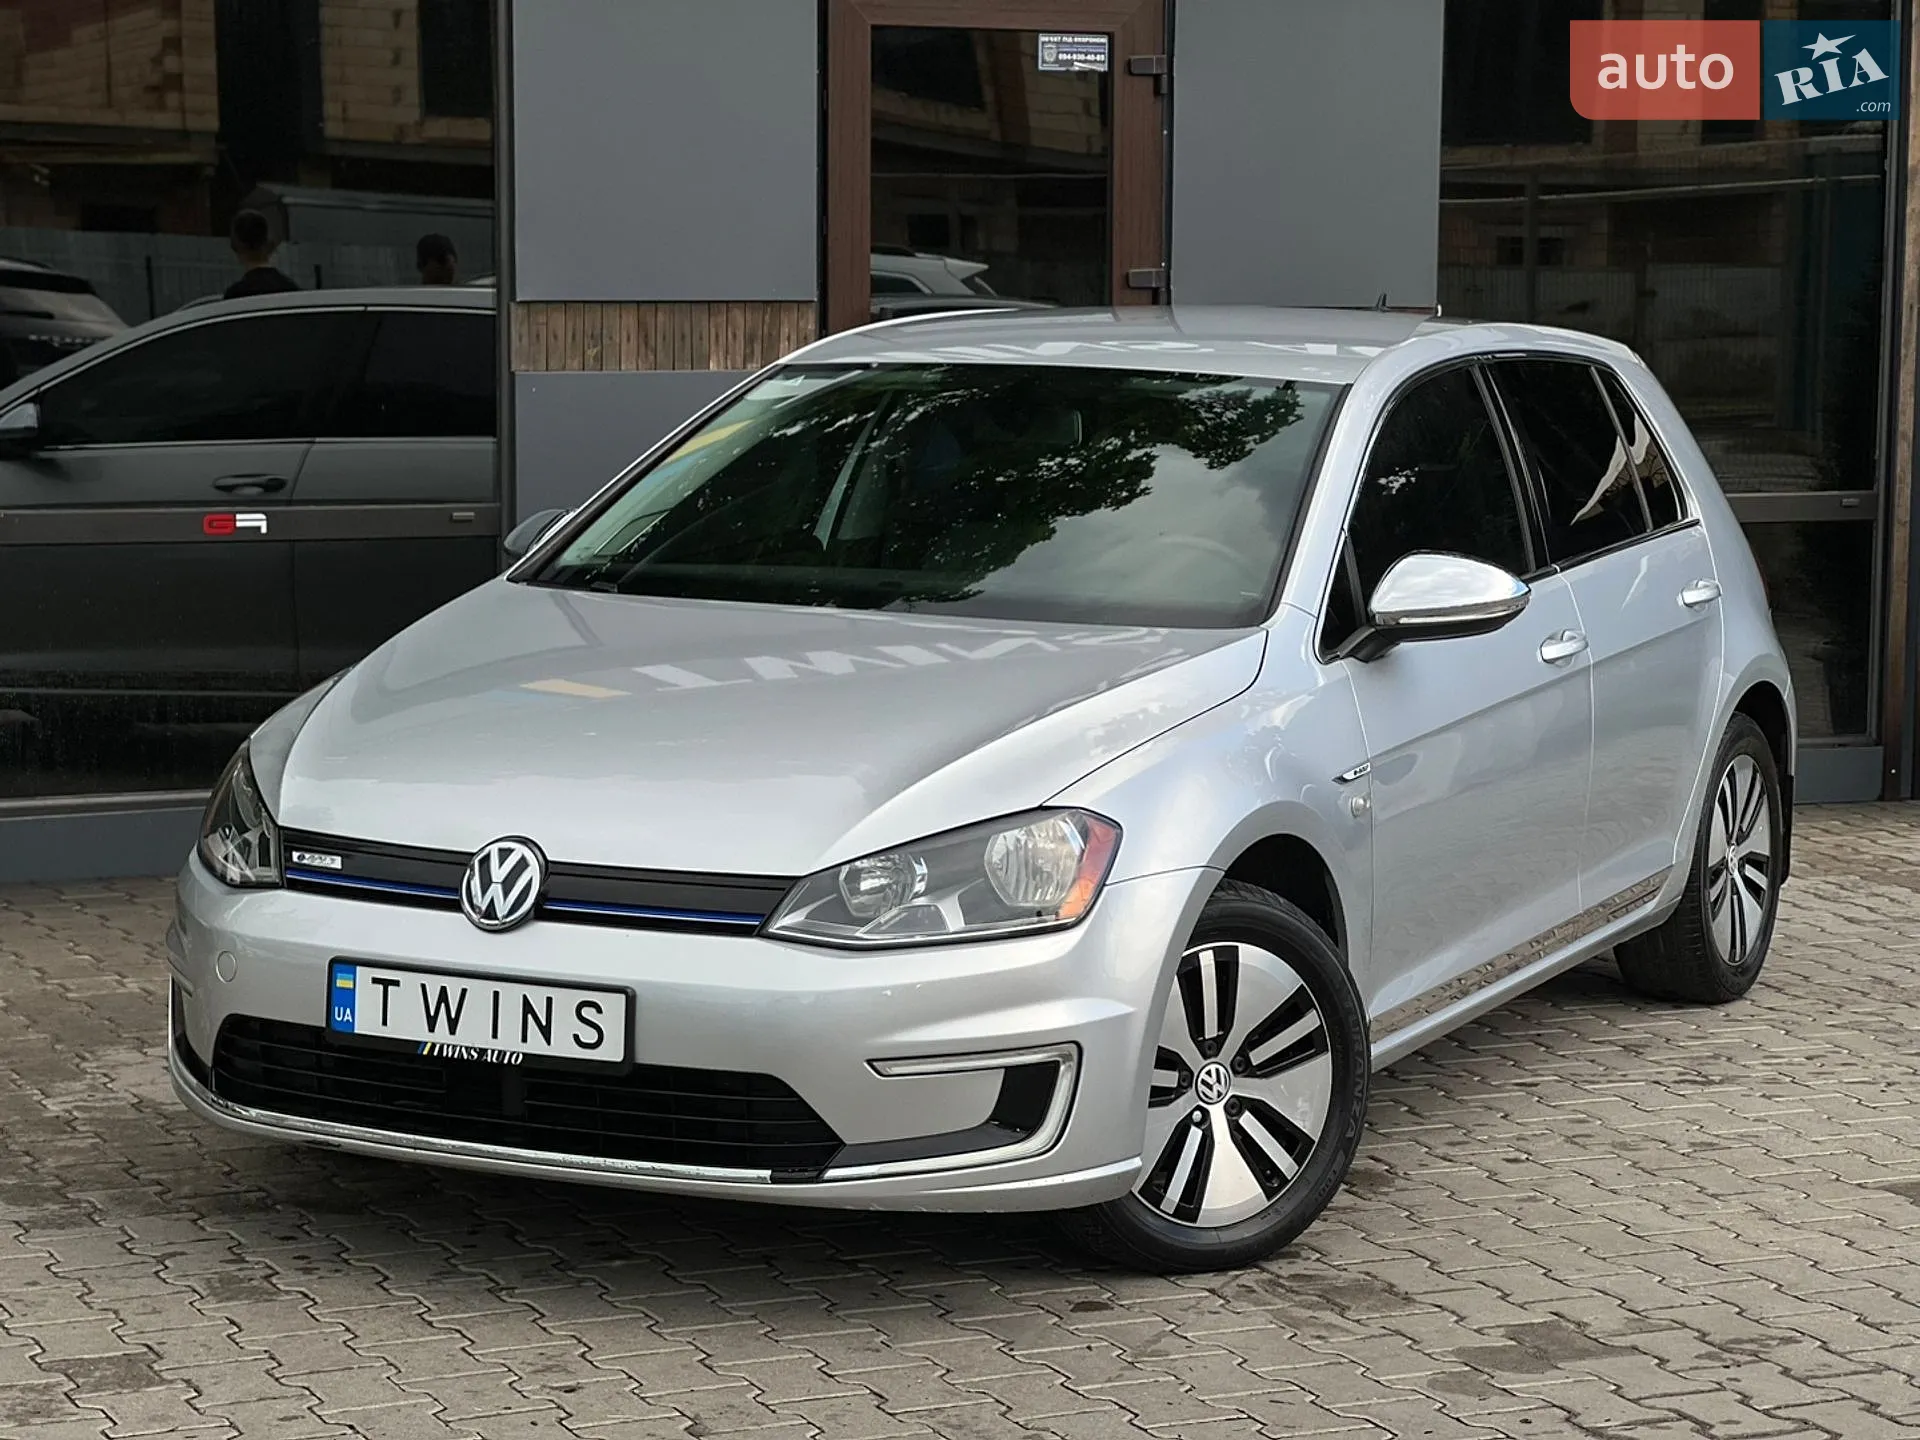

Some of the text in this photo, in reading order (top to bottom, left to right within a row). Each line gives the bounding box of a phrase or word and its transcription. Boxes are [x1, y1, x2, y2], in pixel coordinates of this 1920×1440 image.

[462, 841, 540, 925] VW
[334, 1005, 354, 1023] UA
[370, 976, 605, 1050] TWINS
[433, 1043, 524, 1065] TWINS AUTO
